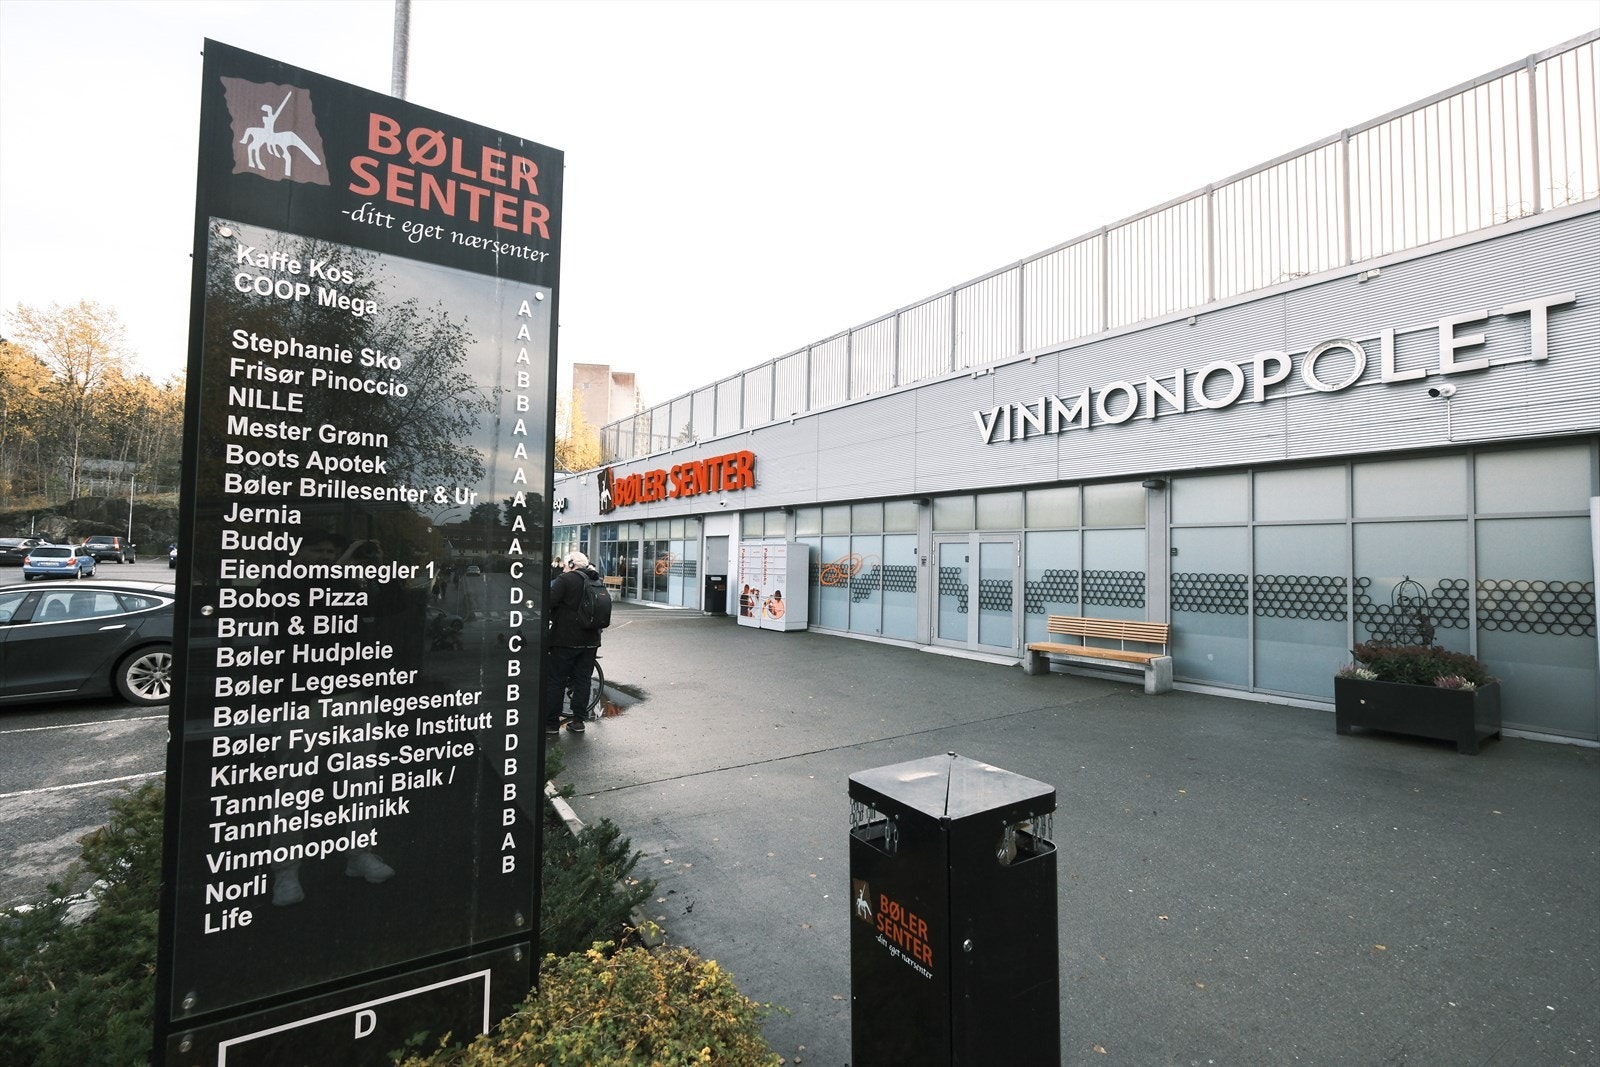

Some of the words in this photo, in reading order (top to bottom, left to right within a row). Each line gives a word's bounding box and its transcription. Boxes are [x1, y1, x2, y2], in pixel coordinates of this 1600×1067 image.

[368, 112, 539, 196] BØLER
[349, 155, 550, 240] SENTER
[342, 202, 395, 230] -ditt
[402, 219, 445, 244] eget
[450, 230, 550, 263] nærsenter
[237, 245, 301, 275] Kaffe
[310, 259, 354, 284] Kos
[234, 273, 311, 302] COOP
[318, 287, 378, 317] Mega
[518, 300, 532, 318] A
[517, 324, 531, 342] A
[232, 329, 353, 365] Stephanie
[360, 348, 402, 371] Sko
[516, 348, 530, 365] A
[230, 357, 304, 385] Frisør
[312, 370, 408, 398] Pinoccio
[517, 371, 530, 388] B
[974, 291, 1577, 445] VINMONOPOLET
[229, 386, 303, 413] NILLE
[517, 395, 529, 412] B
[227, 415, 312, 441] Mester
[318, 423, 388, 448] Grønn
[514, 419, 528, 436] A
[225, 444, 299, 468] Boots
[306, 450, 387, 475] Apotek
[514, 443, 527, 460] A
[513, 467, 527, 484] A
[615, 469, 667, 507] BØLER
[669, 450, 756, 499] SENTER
[224, 473, 292, 496] Bøler
[300, 478, 428, 503] Brillesenter
[434, 486, 449, 504] &
[455, 487, 478, 505] Ur
[512, 491, 526, 508] A
[223, 503, 301, 525] Jernia
[512, 515, 525, 532] A
[221, 530, 303, 556] Buddy
[508, 538, 522, 555] A
[220, 559, 419, 584] Eiendomsmegler
[425, 561, 435, 579] 1
[510, 562, 523, 579] C
[219, 588, 300, 609] Bobos
[309, 587, 368, 607] Pizza
[510, 587, 523, 604] D
[217, 617, 279, 638] Brun
[287, 616, 305, 636] &
[313, 615, 358, 635] Blid
[510, 611, 522, 628] D
[216, 646, 285, 668] Bøler
[292, 641, 393, 666] Hudpleie
[508, 635, 522, 653] C
[508, 660, 520, 677] B
[215, 675, 284, 697] Bøler
[291, 667, 418, 695] Legesenter
[507, 684, 520, 701] B
[213, 701, 310, 727] Bølerlia
[318, 688, 482, 718] Tannlegesenter
[506, 709, 519, 726] B
[212, 733, 281, 757] Bøler
[289, 721, 409, 753] Fysikalske
[416, 711, 493, 736] Institutt
[505, 734, 518, 751] D
[211, 756, 319, 787] Kirkerud
[327, 740, 475, 774] Glass-Service
[504, 758, 517, 776] B
[210, 785, 324, 817] Tannlege
[333, 776, 384, 800] Unni
[391, 769, 443, 792] Bialk
[448, 766, 456, 784] /
[503, 783, 516, 801] B
[209, 796, 410, 844] Tannhelseklinikk
[502, 808, 515, 826] B
[206, 828, 378, 874] Vinmonopolet
[501, 833, 515, 850] A
[502, 856, 515, 873] B
[205, 873, 267, 905] Norli
[204, 905, 253, 934] Life
[880, 893, 928, 942] BØLER
[877, 912, 933, 968] SENTER
[354, 1009, 377, 1039] D
